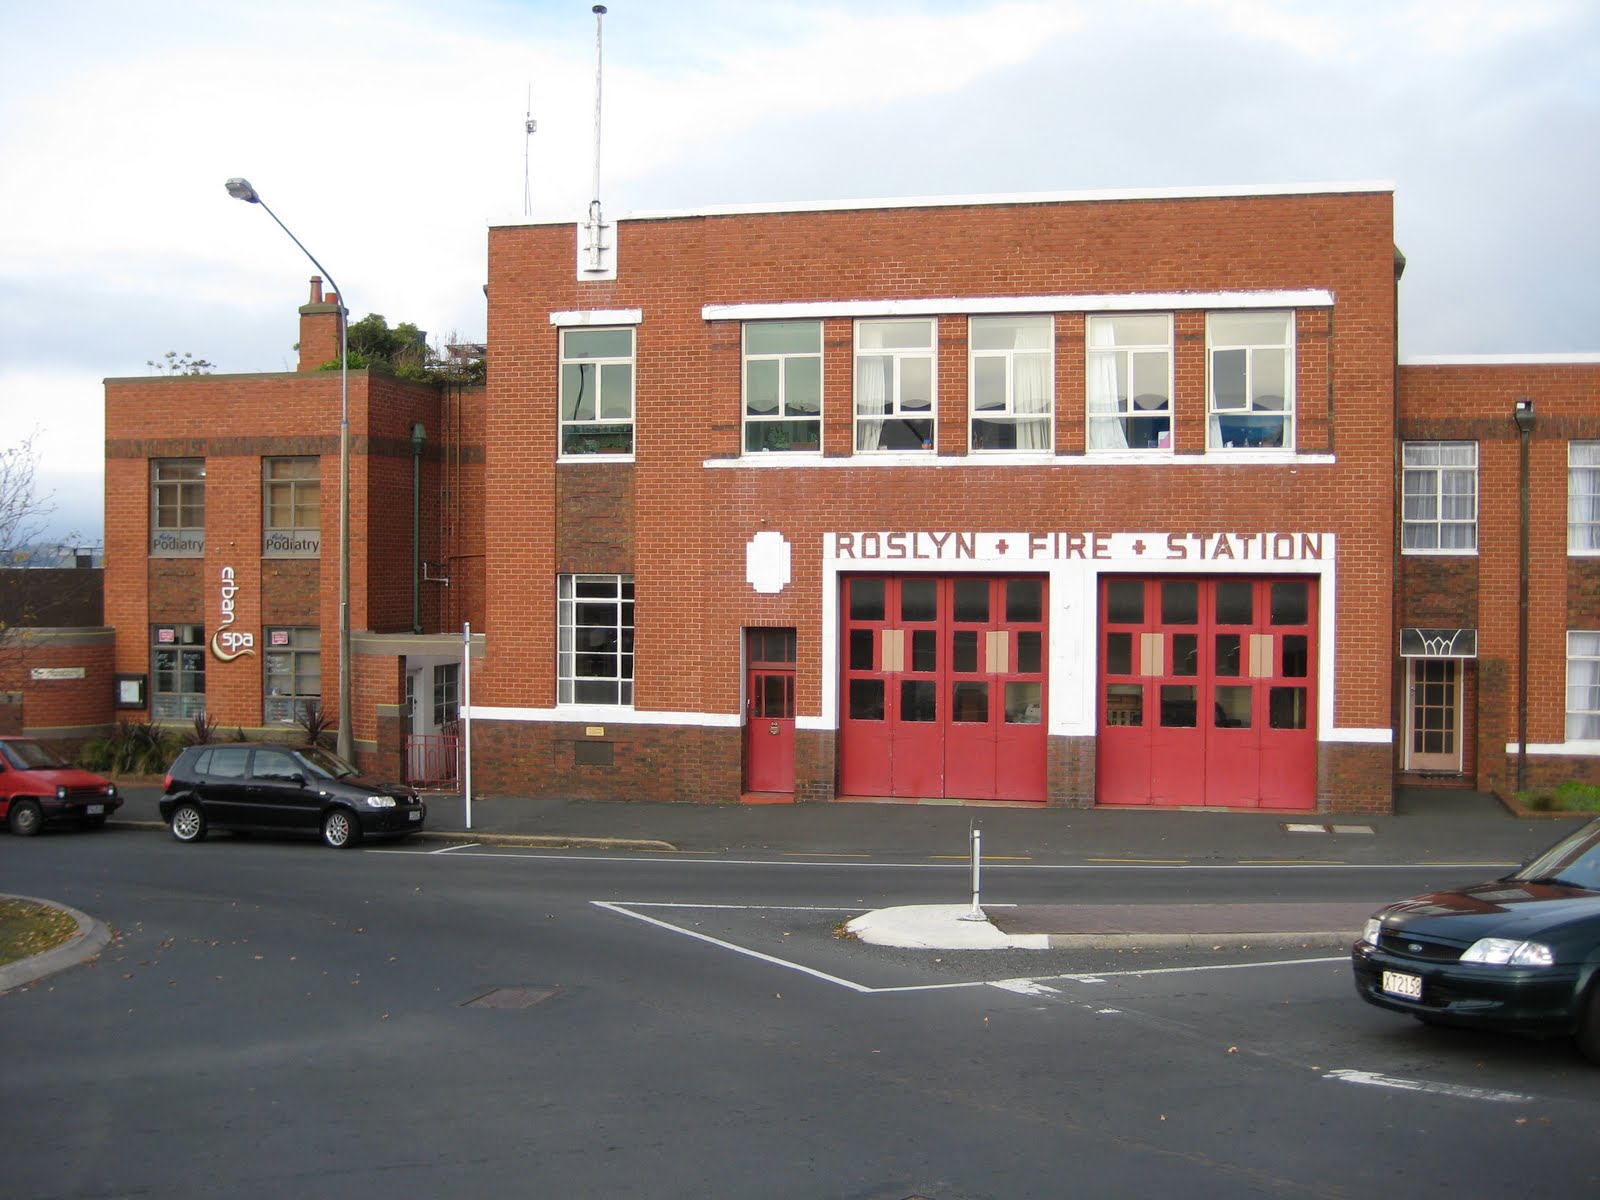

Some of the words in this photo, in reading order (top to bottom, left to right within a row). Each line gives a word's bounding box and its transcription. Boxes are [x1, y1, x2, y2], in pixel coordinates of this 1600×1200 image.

[153, 538, 204, 552] Podiatry
[266, 538, 320, 552] Podiatry
[836, 532, 976, 559] ROSLYN
[1029, 532, 1112, 559] FIRE
[1166, 532, 1323, 560] STATION
[221, 566, 239, 624] erban
[222, 632, 253, 652] spa
